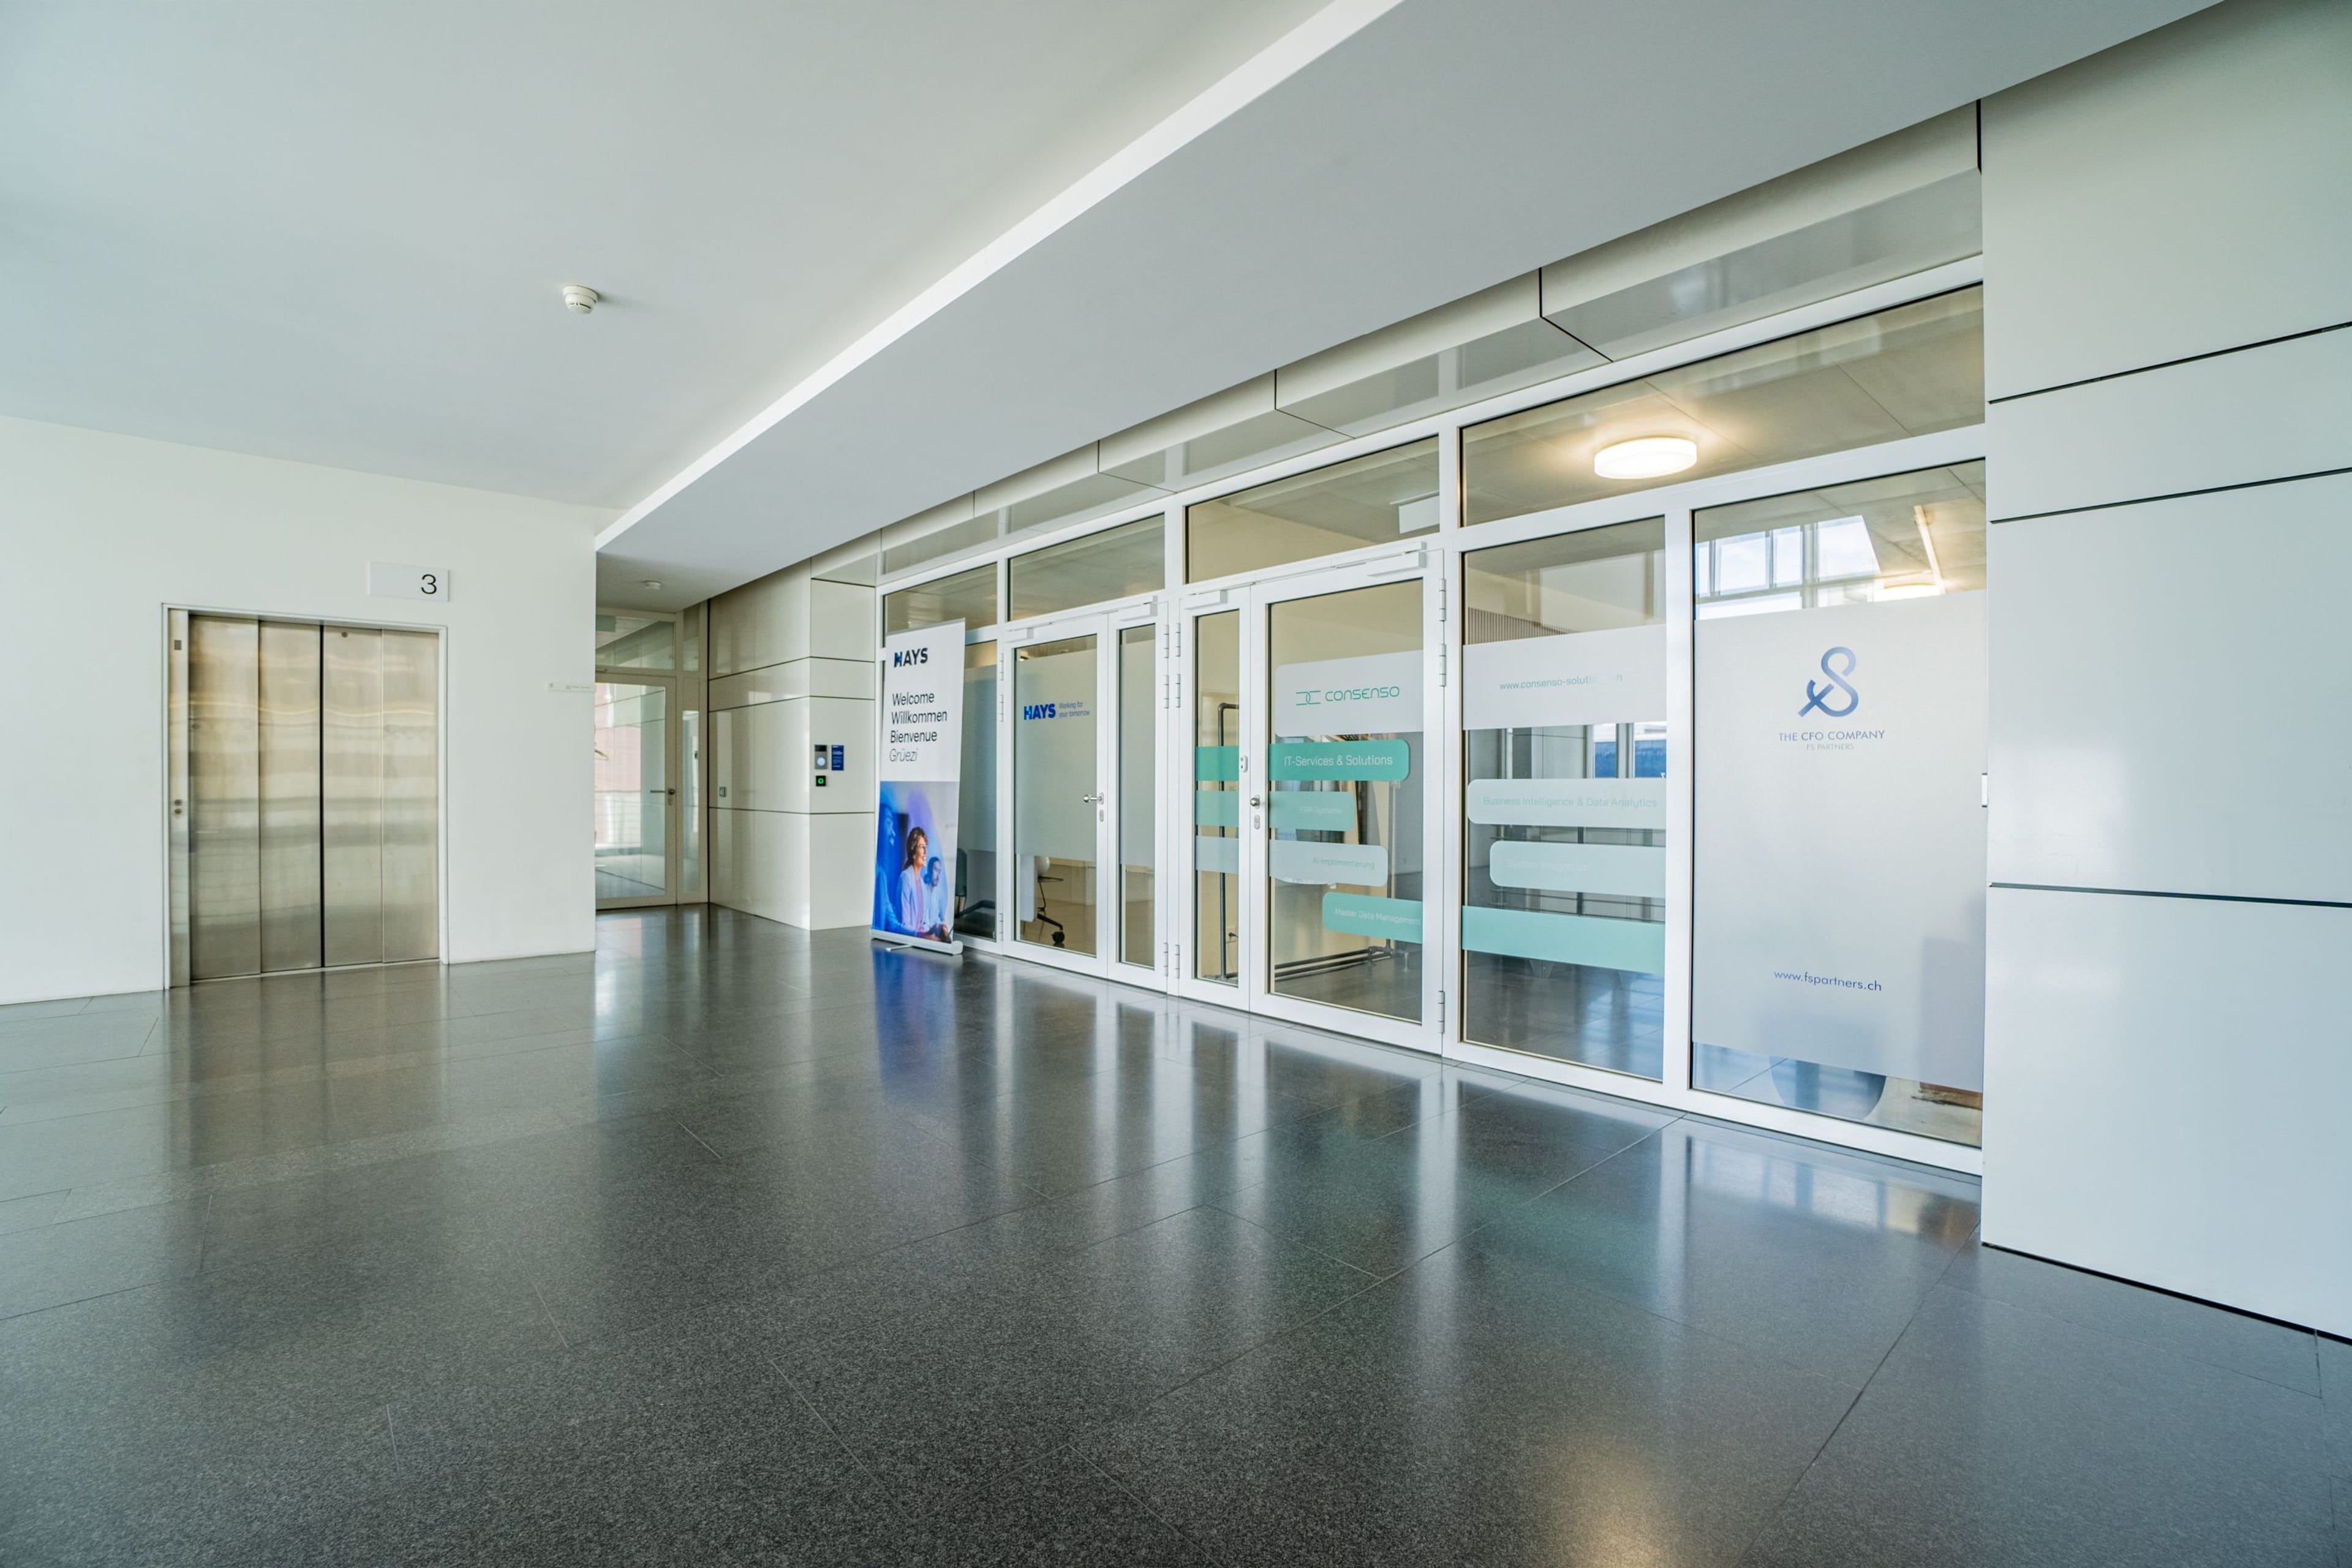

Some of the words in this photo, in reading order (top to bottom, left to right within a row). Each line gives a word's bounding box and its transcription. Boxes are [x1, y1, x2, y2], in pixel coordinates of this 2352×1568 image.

[421, 574, 437, 594] 3
[894, 647, 928, 668] HAYS
[892, 692, 935, 706] Welcome
[891, 711, 948, 725] Willkommen
[1024, 703, 1056, 720] HAYS
[890, 730, 938, 744] Bienvenue
[1779, 733, 1797, 741] THE
[1801, 731, 1823, 741] CFO
[1828, 730, 1885, 740] COMPANY
[889, 748, 919, 762] Grüezi
[1284, 755, 1333, 766] IT-Services
[1336, 755, 1343, 766] &
[1346, 755, 1393, 766] Solutions
[1483, 797, 1520, 807] Business
[1523, 797, 1574, 809] Intelligence
[1577, 798, 1584, 807] &
[1587, 798, 1609, 807] Data
[1611, 798, 1658, 809] Analytics
[1334, 907, 1357, 918] Master
[1375, 912, 1421, 926] Management
[1774, 971, 1882, 991] www.fspartners.ch
